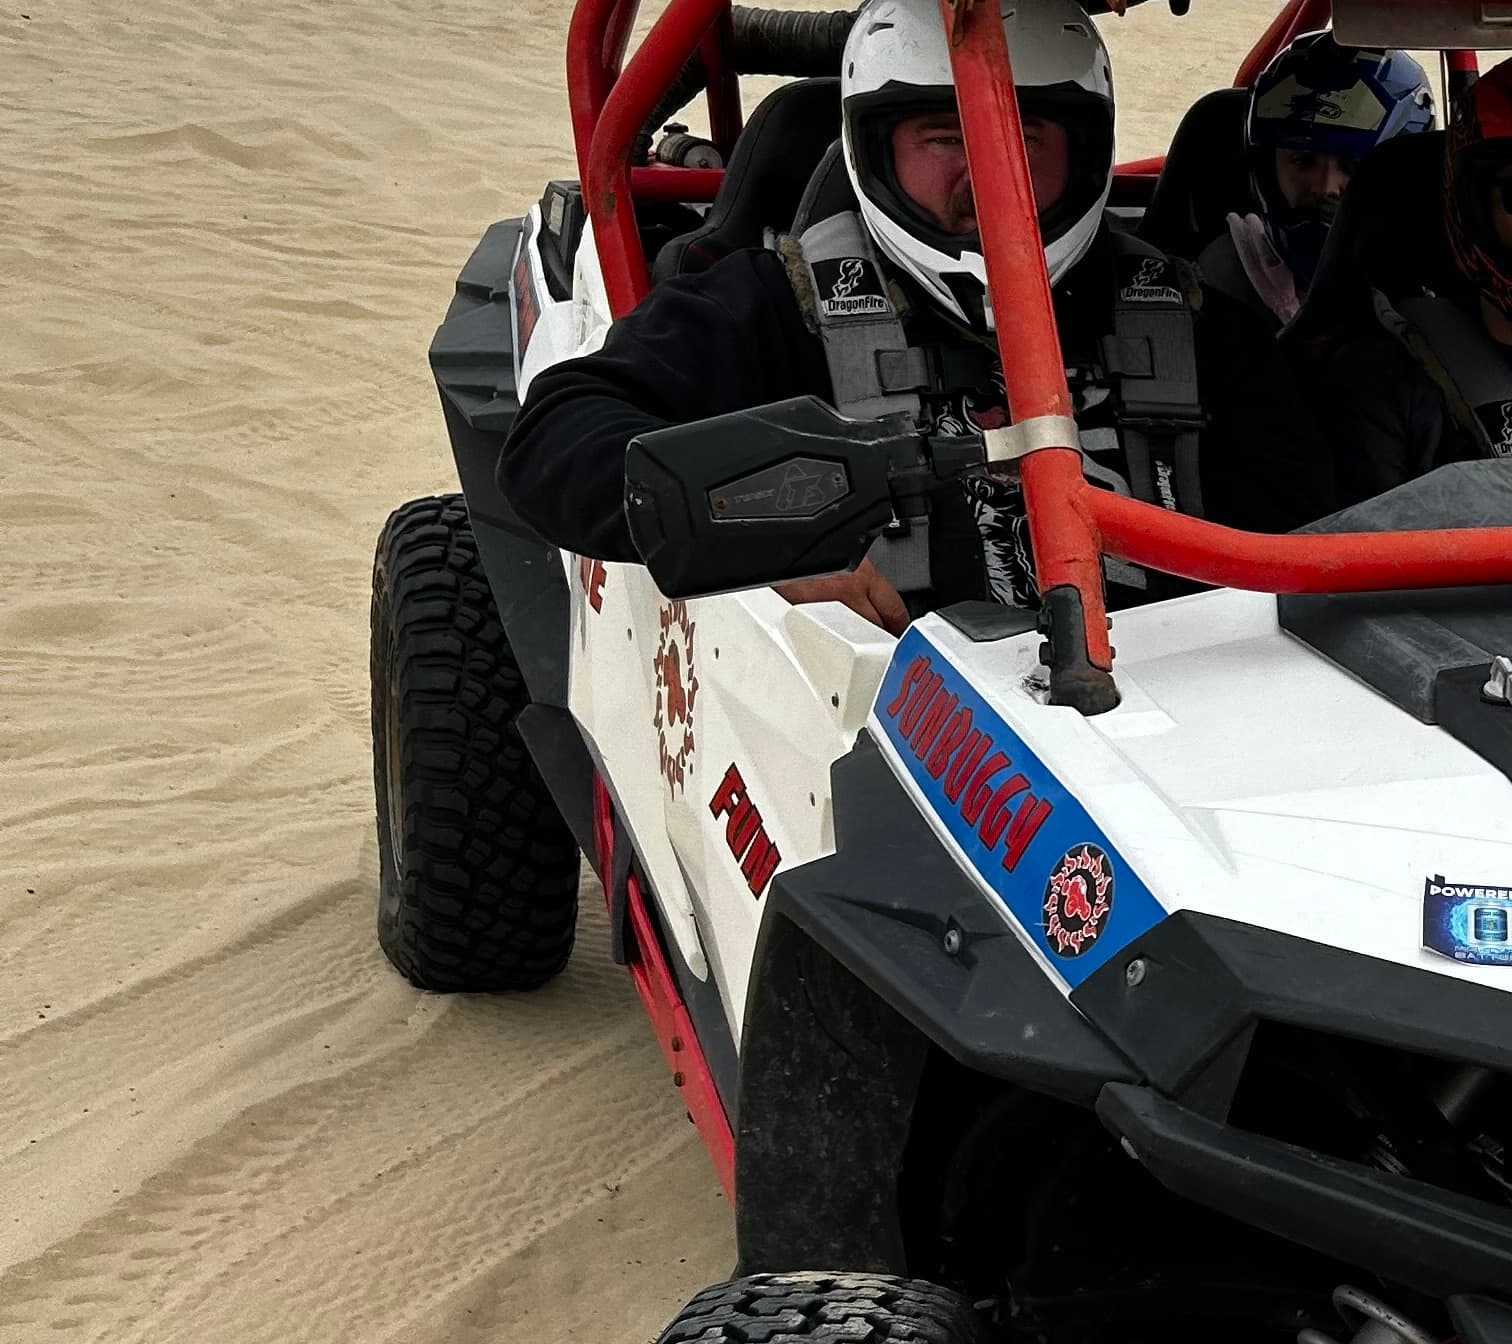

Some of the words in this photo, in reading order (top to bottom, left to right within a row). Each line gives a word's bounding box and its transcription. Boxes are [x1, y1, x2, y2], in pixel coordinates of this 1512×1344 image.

[828, 296, 885, 313] DragonFire
[708, 761, 783, 902] FUN
[886, 655, 1054, 874] SUNBUGGY
